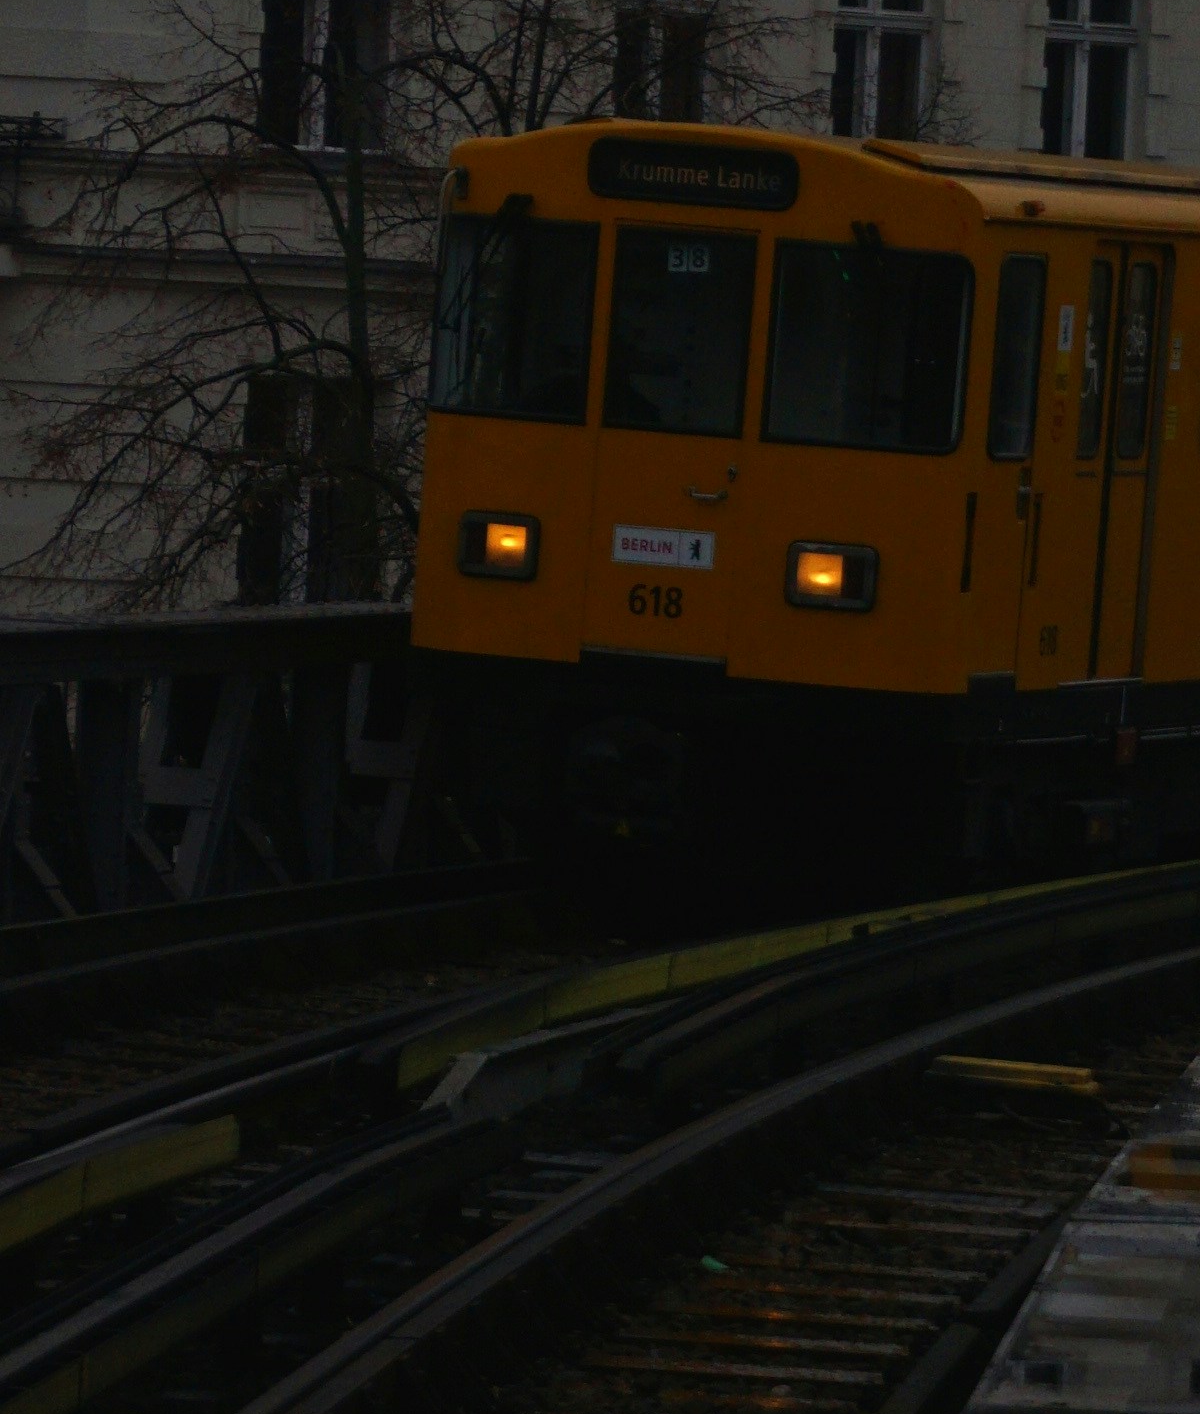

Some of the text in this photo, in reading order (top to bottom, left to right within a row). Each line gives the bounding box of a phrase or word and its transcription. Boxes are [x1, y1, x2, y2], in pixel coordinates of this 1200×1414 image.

[618, 157, 783, 192] Krumme Lanke
[671, 246, 706, 269] 38
[621, 537, 673, 555] BERLIN
[628, 583, 683, 619] 618
